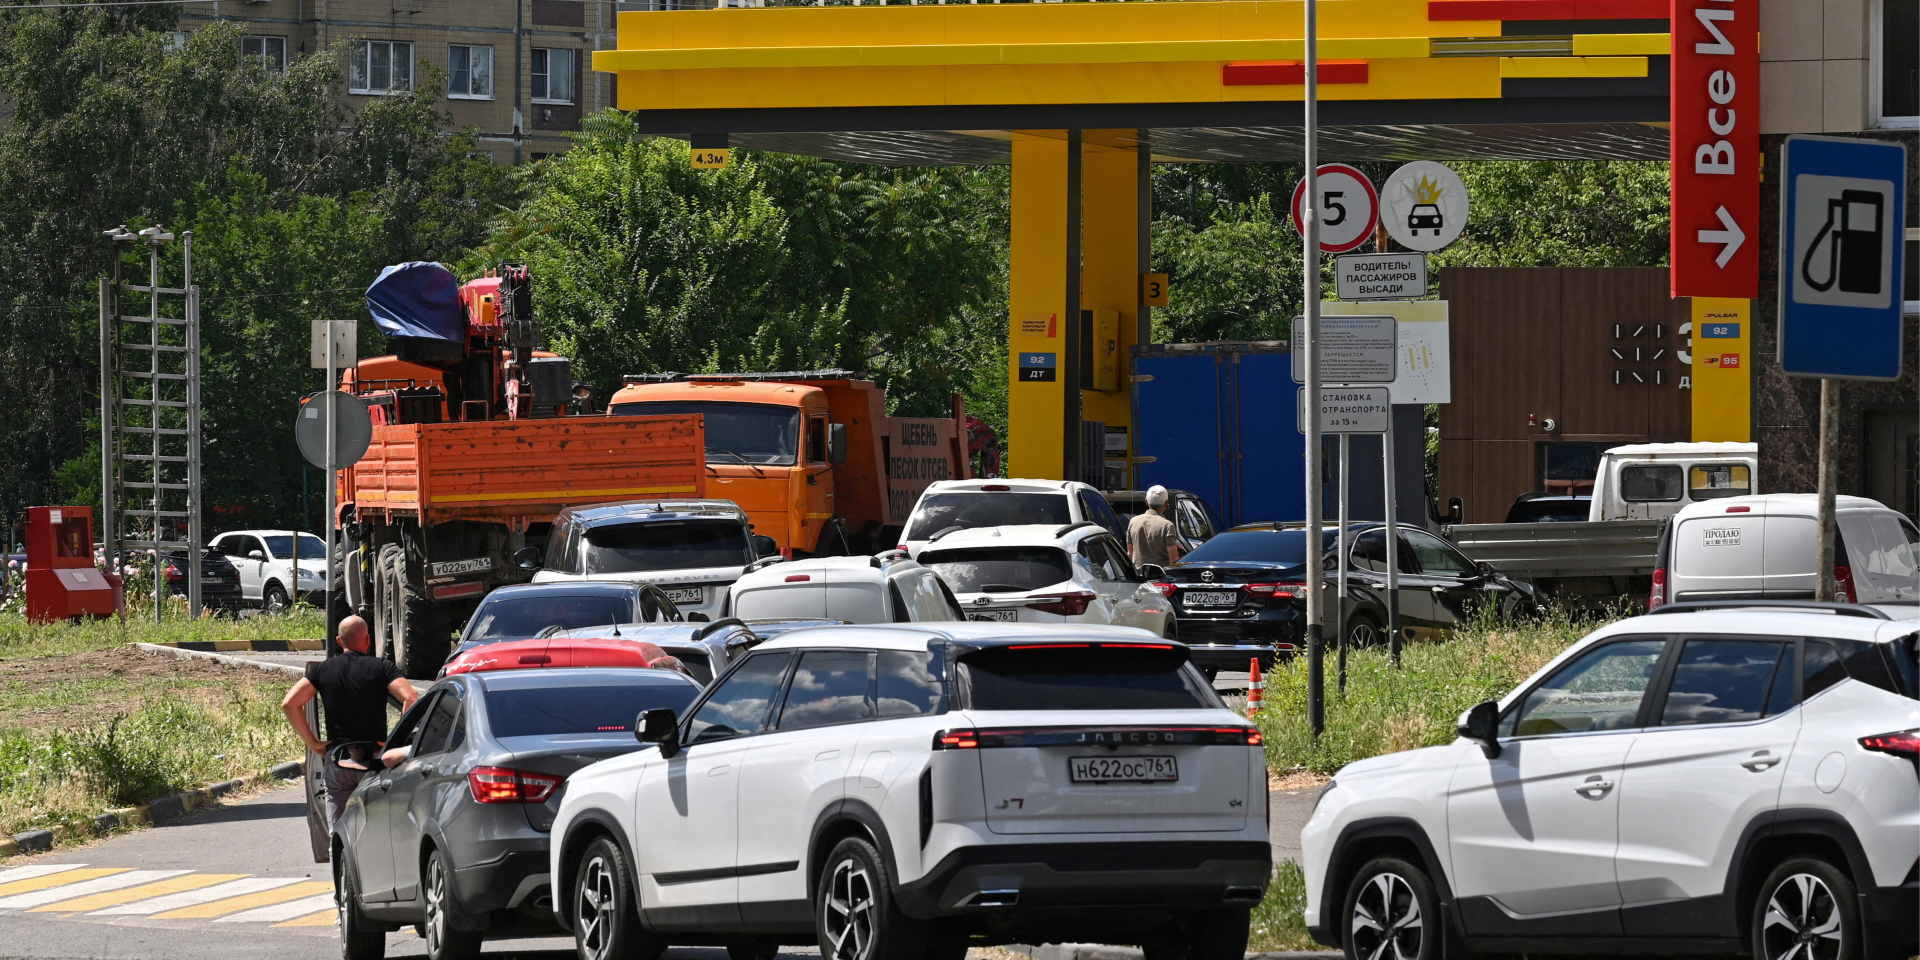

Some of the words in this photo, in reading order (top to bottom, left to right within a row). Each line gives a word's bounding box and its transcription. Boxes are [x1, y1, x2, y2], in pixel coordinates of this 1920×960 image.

[1695, 0, 1735, 55] И
[1695, 70, 1736, 175] Все
[1324, 191, 1347, 226] 5
[1354, 261, 1411, 272] ВОДИТЕЛЬ!
[1346, 272, 1417, 283] ПАССАЖИРОВ
[1149, 282, 1160, 298] 3
[1359, 284, 1403, 294] ВЫСАДИ
[1713, 327, 1728, 335] 92
[1030, 356, 1045, 364] 92
[1322, 394, 1372, 402] СТАНОВКА
[902, 423, 937, 449] ЩЕБЕНЬ
[891, 457, 919, 480] ПЕСОК
[1705, 530, 1739, 538] ПРОДАЮ
[474, 558, 490, 567] 761
[683, 589, 699, 597] 761
[1186, 593, 1219, 603] В022ОВ
[998, 612, 1014, 620] 761
[1077, 760, 1144, 778] Н622ОС
[1146, 758, 1173, 772] 761
[995, 798, 1024, 809] J7
